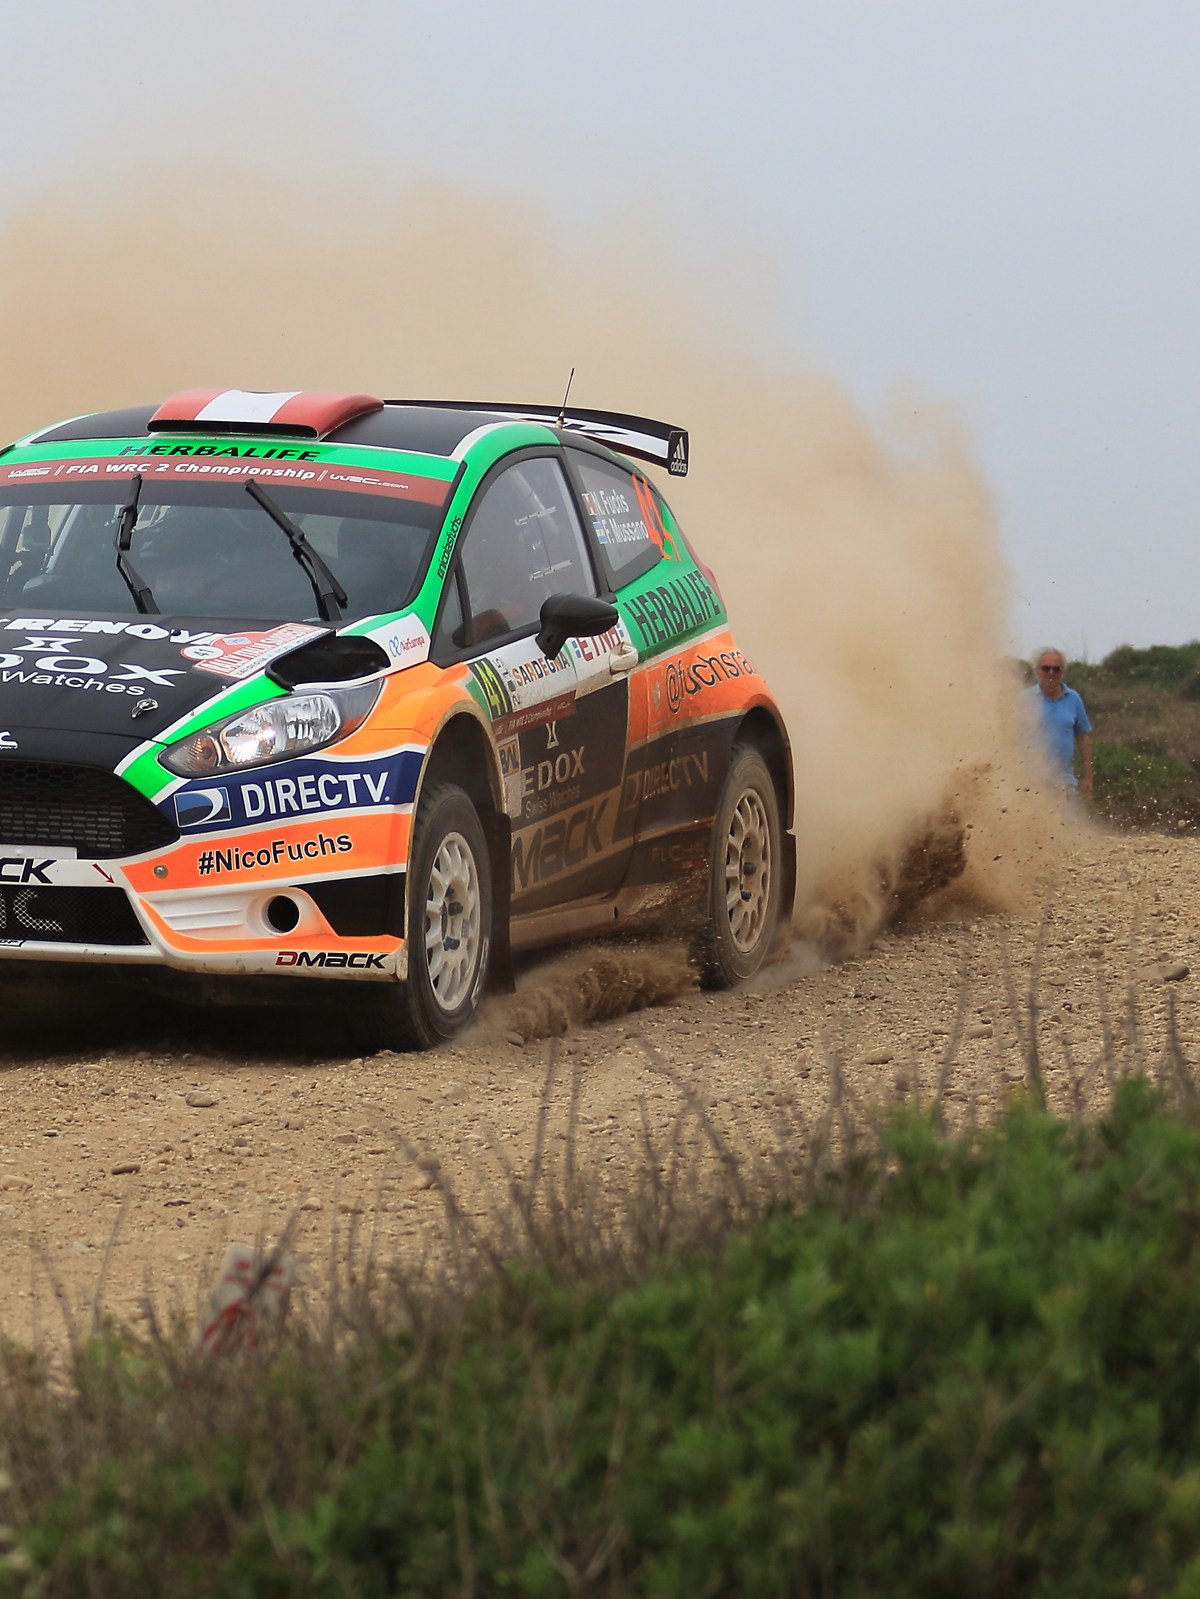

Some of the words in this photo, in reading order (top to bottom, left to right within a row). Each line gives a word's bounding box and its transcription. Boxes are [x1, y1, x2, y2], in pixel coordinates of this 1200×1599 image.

[118, 445, 320, 461] HERBALIFE
[671, 459, 687, 473] adidas
[66, 464, 99, 474] FIA
[105, 463, 151, 473] WRC
[155, 463, 170, 472] 2
[174, 463, 316, 481] Championship
[623, 570, 721, 648] HERBALIFE
[512, 650, 571, 686] SARDEGNA
[2, 671, 145, 696] Watches
[521, 746, 586, 798] EDOX
[198, 834, 353, 875] #NicoFuchs
